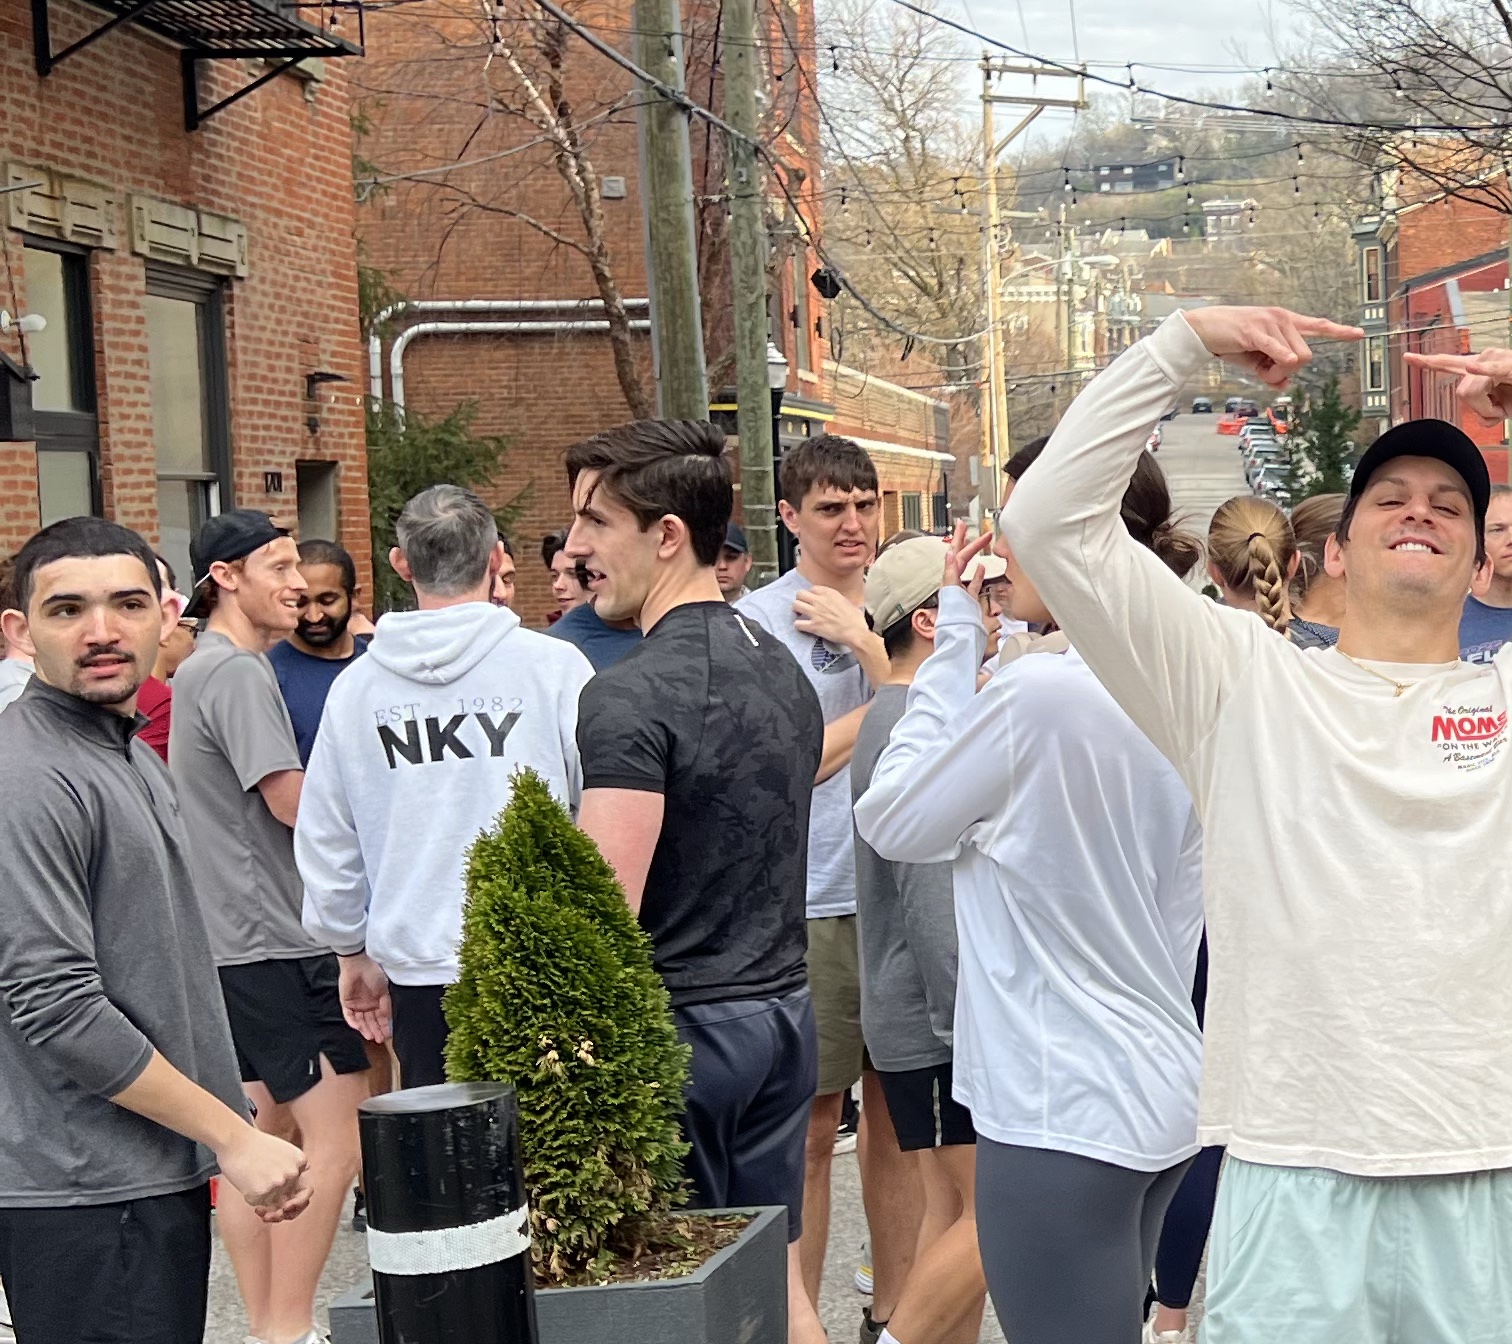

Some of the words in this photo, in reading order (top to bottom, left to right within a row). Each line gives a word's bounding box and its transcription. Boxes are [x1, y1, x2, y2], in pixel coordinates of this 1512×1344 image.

[457, 696, 523, 714] 1982
[377, 712, 523, 769] NKY
[1431, 711, 1507, 742] MOMS
